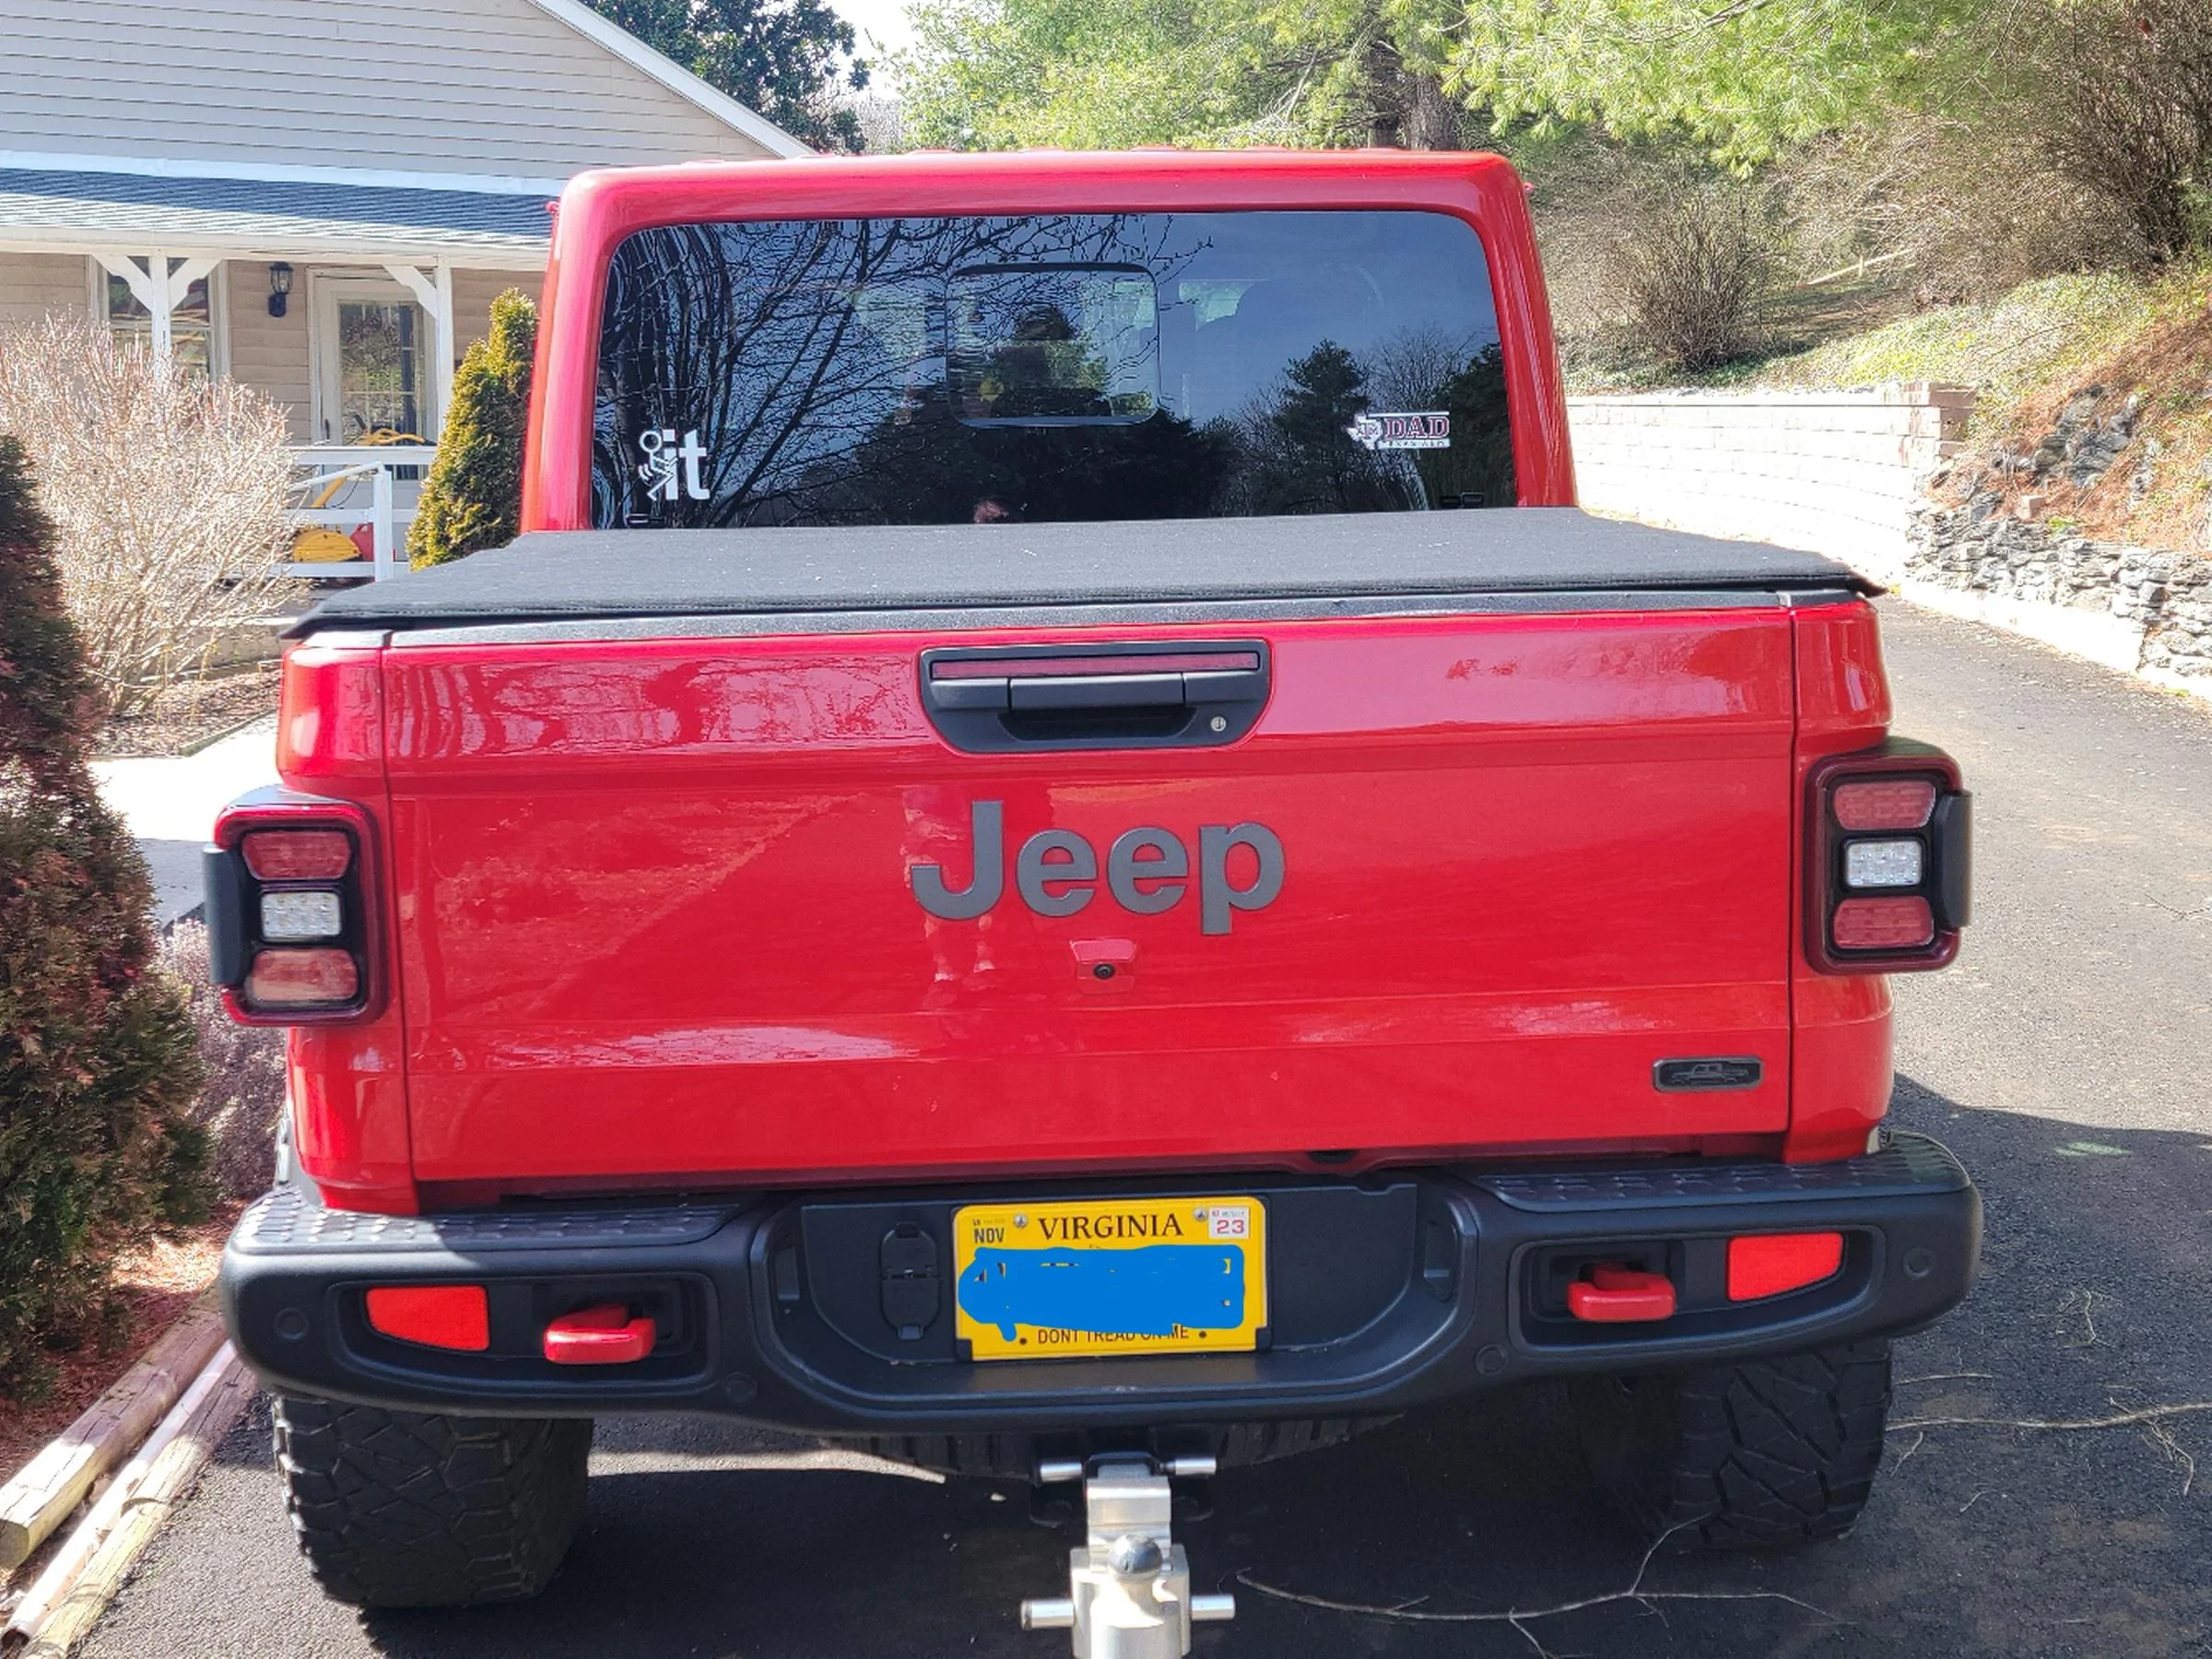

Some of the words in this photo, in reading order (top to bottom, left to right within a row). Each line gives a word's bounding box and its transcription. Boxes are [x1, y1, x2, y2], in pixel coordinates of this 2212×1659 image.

[1384, 416, 1450, 440] DAD
[662, 429, 711, 500] it
[911, 799, 1287, 936] Jeep
[973, 1227, 1005, 1244] NOV
[1037, 1213, 1184, 1241] VIRGINIA
[1217, 1219, 1244, 1234] 23
[1038, 1328, 1078, 1344] DONT
